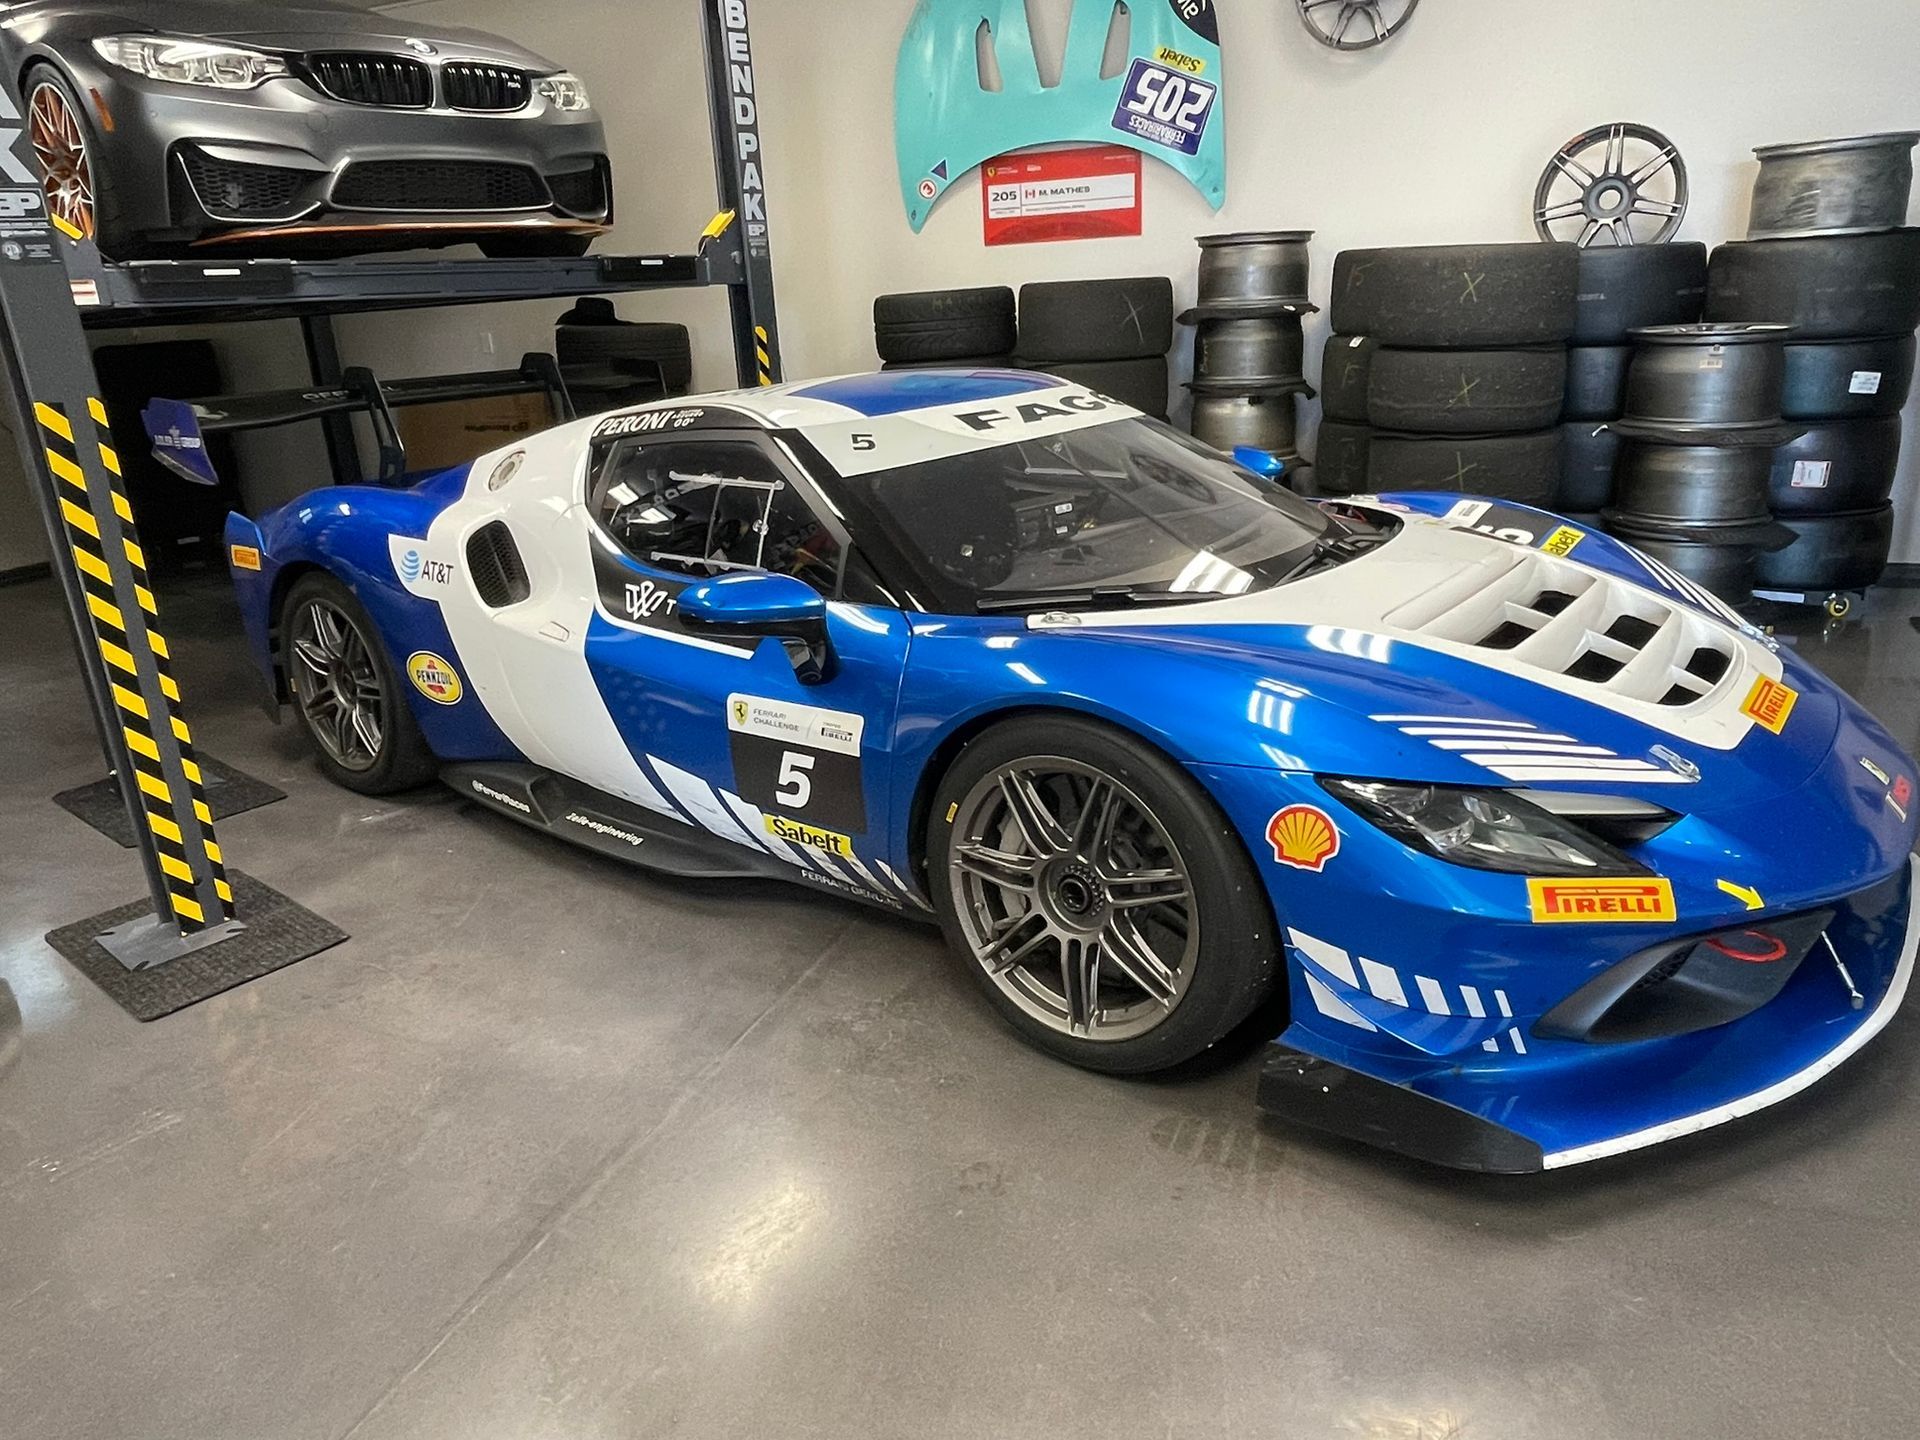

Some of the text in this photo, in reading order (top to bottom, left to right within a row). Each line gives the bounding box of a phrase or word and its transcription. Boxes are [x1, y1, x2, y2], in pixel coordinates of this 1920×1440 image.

[1160, 48, 1200, 71] Sabelt
[724, 0, 765, 220] BENDPAK
[1127, 68, 1213, 131] 205
[992, 190, 1017, 202] 205
[592, 410, 675, 437] PERONI
[851, 433, 876, 450] 5
[1548, 530, 1580, 556] abelt
[421, 559, 455, 585] AT&T
[416, 669, 453, 686] PENNZOIL
[753, 708, 787, 720] FERRARI
[1748, 679, 1790, 726] PIRELLI
[753, 717, 800, 732] CHALLENGE
[775, 751, 815, 809] 5
[772, 819, 843, 854] Sabelt
[1542, 886, 1662, 914] PIRELLI
